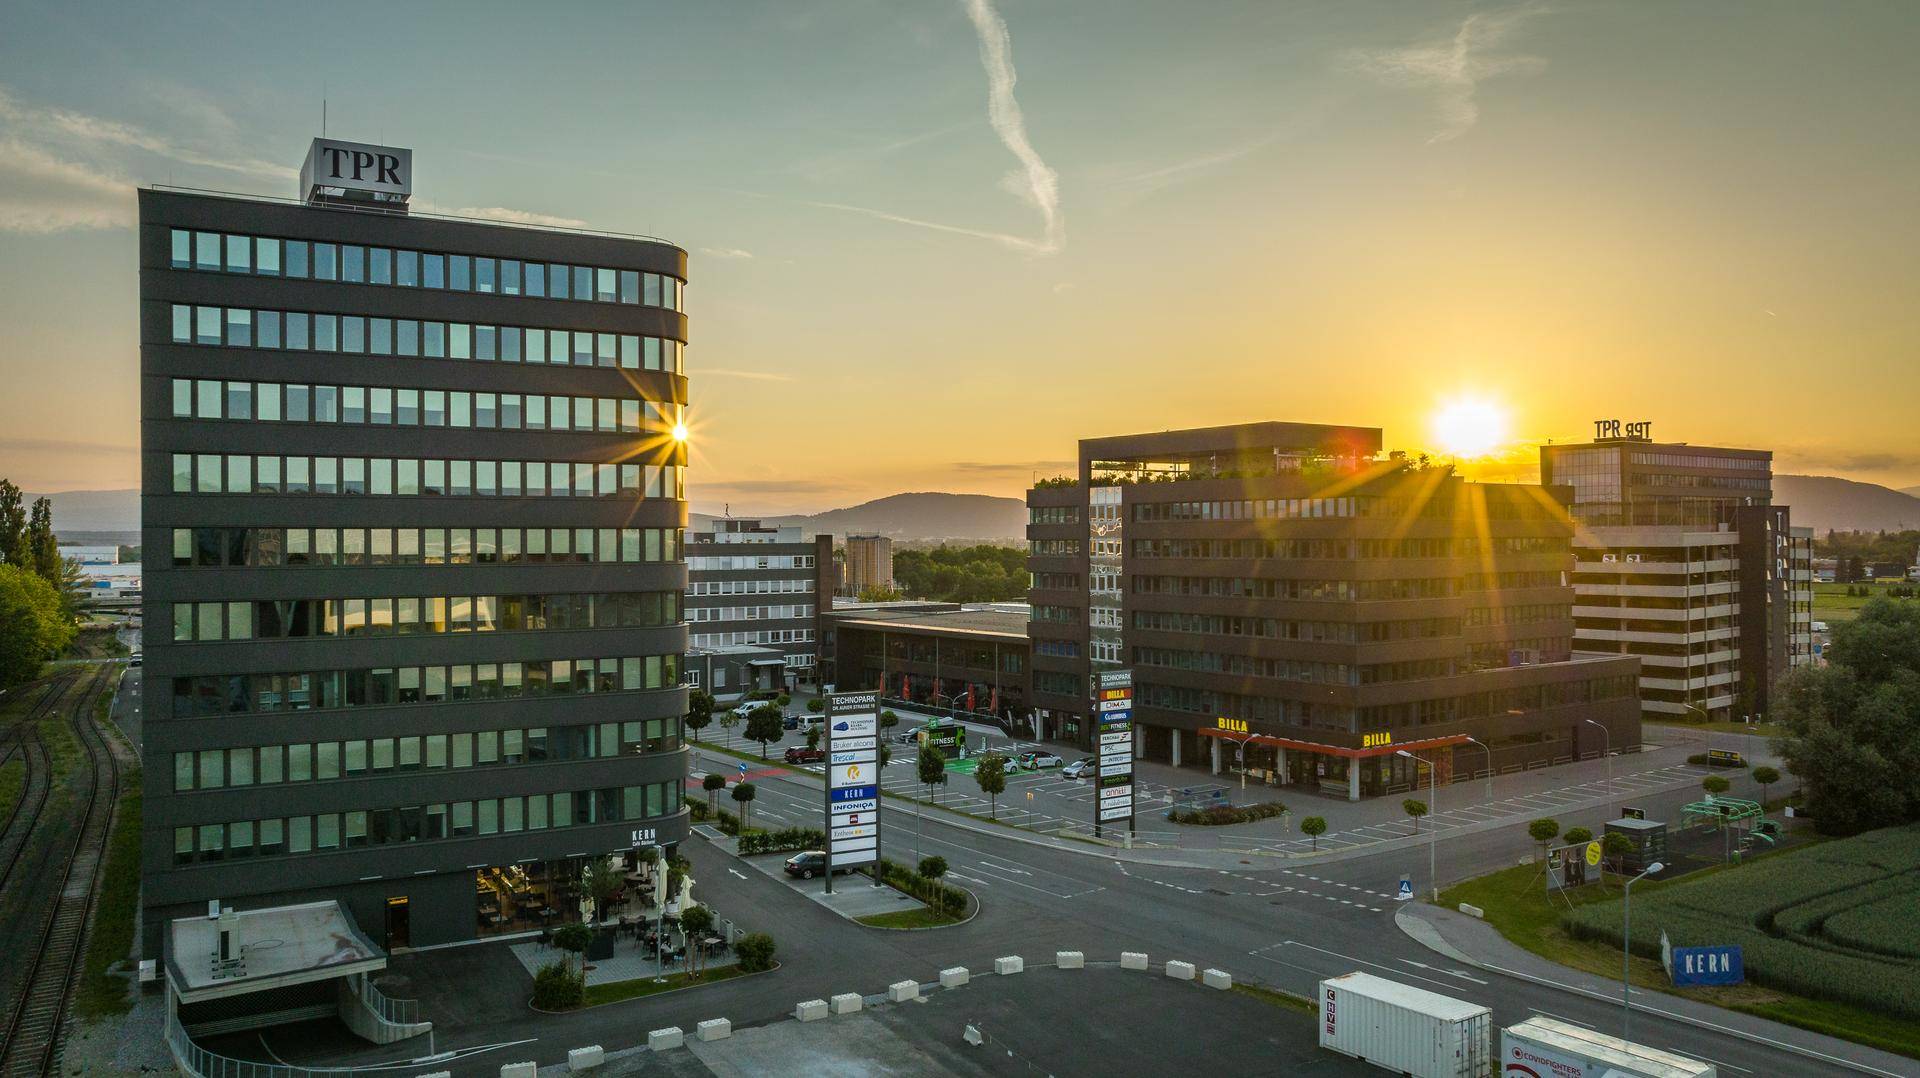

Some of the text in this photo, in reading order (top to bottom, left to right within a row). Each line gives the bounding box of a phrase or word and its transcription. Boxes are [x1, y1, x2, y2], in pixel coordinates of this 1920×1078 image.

[323, 147, 402, 185] TPR
[1594, 419, 1621, 438] TPR
[1101, 673, 1131, 682] TECHNOPARK
[832, 695, 876, 705] TECHNOPARK
[1106, 690, 1124, 699] BILLA
[1105, 701, 1126, 709] DIMA
[1110, 722, 1128, 730] FITNESS
[1218, 717, 1248, 732] BILLA
[1363, 732, 1392, 748] BILLA
[833, 753, 855, 762] Trescal
[844, 788, 864, 799] KERN
[834, 802, 874, 811] INFONIQA
[632, 828, 656, 841] KERN
[1685, 953, 1730, 974] KERN
[1523, 1052, 1582, 1076] COVIDFIGHTERS
